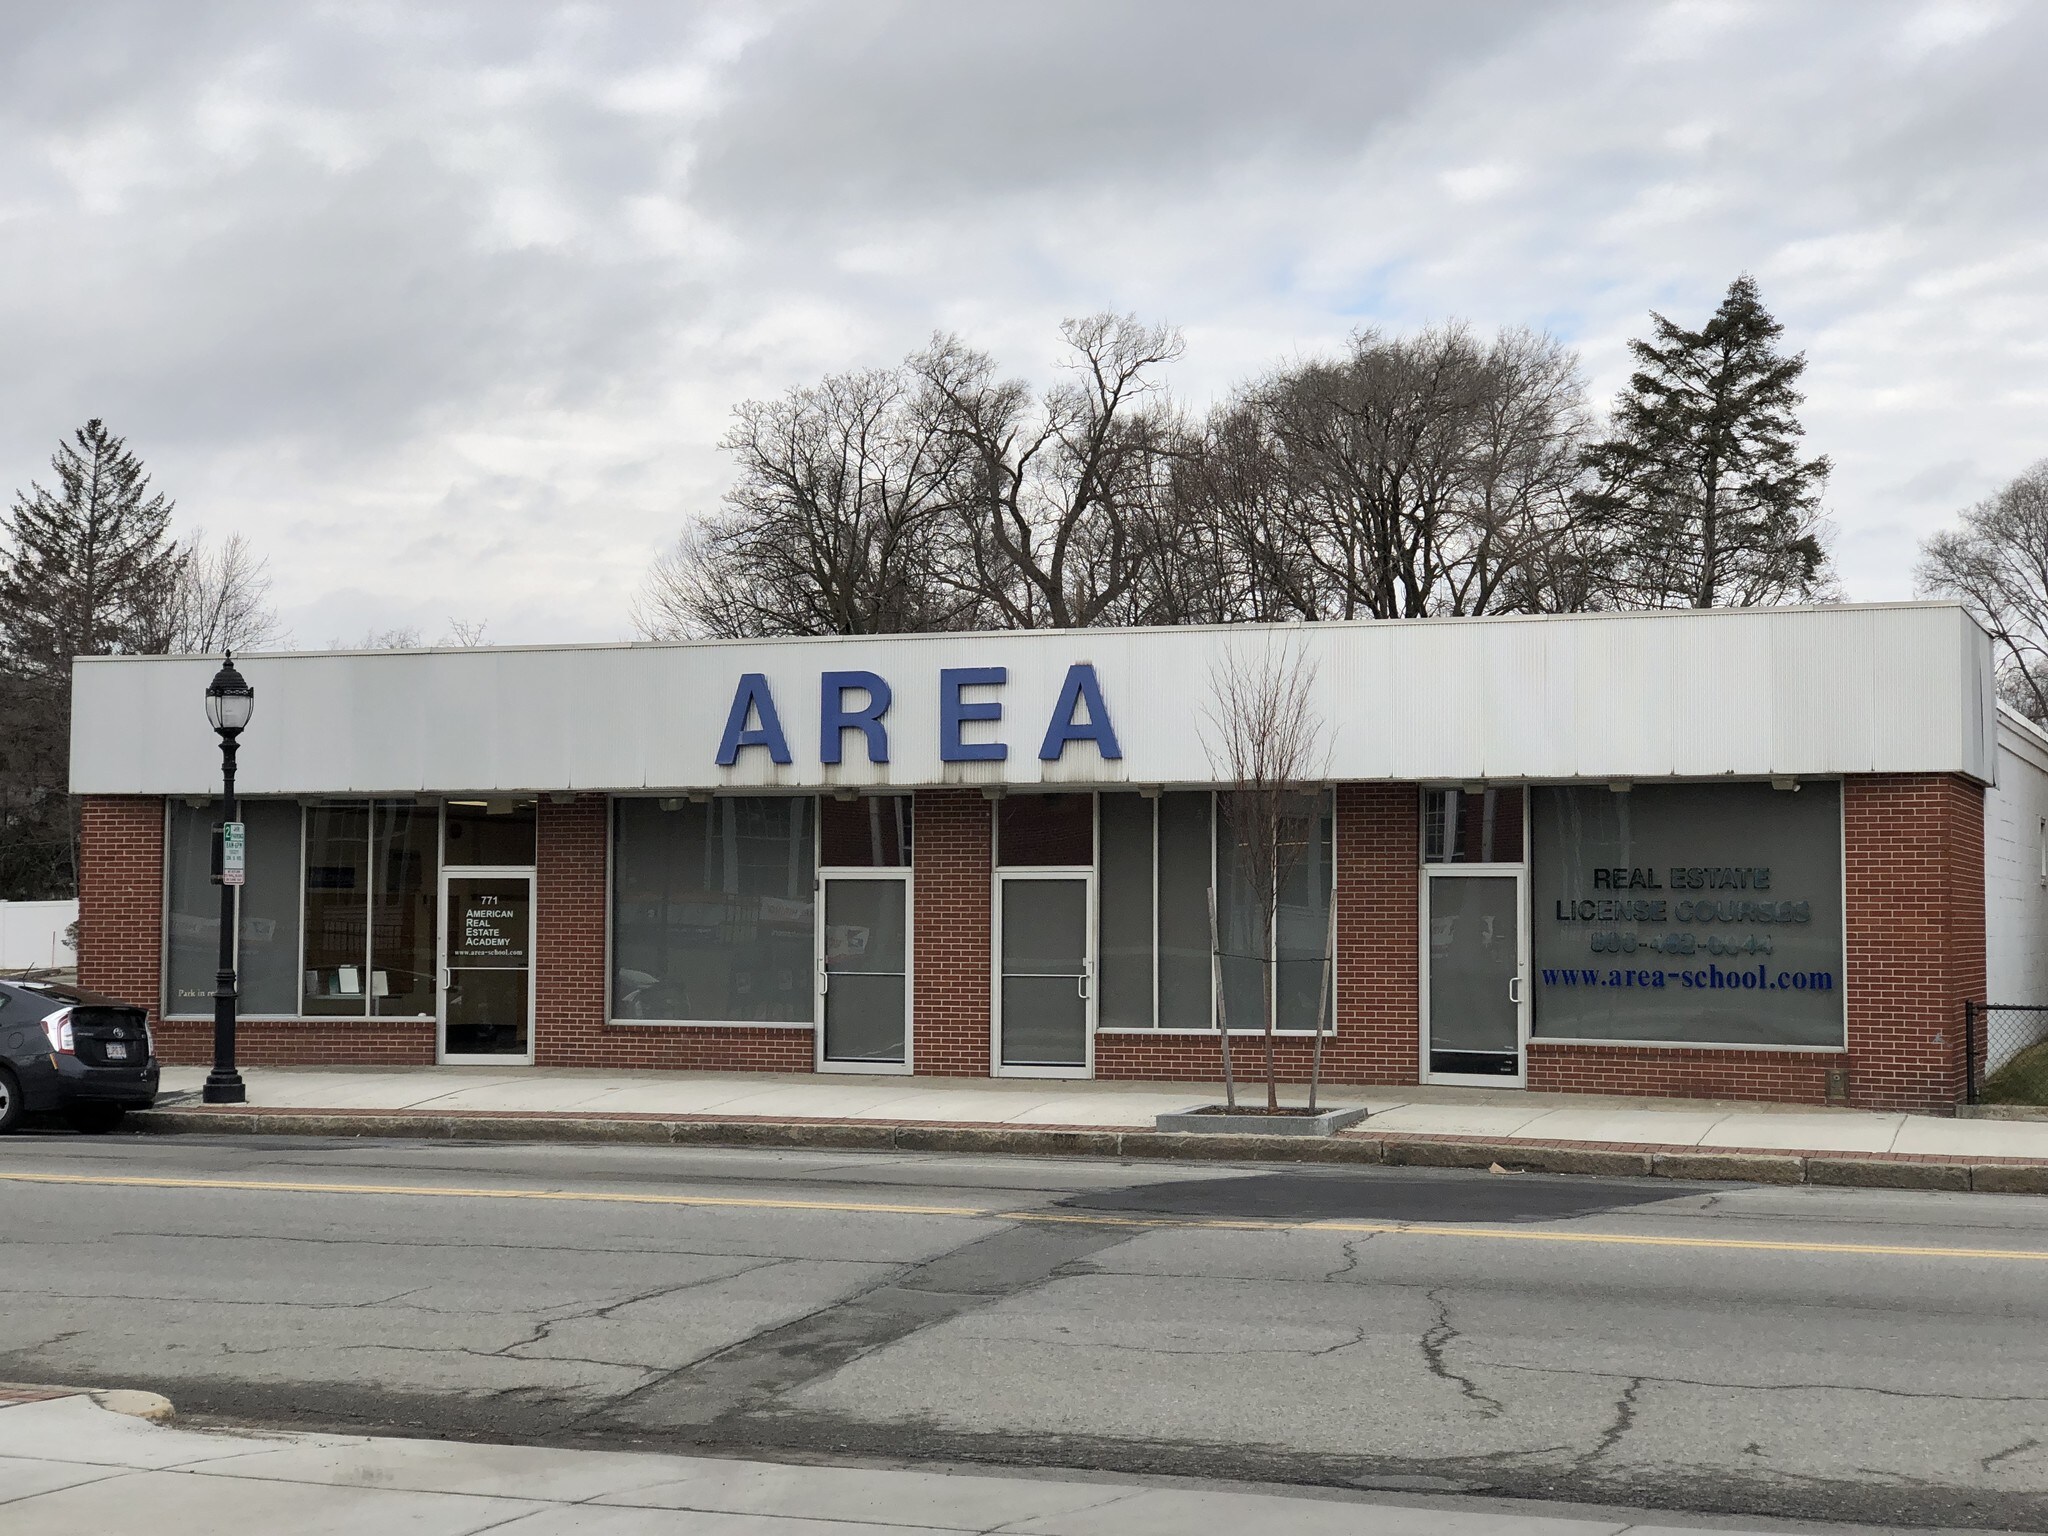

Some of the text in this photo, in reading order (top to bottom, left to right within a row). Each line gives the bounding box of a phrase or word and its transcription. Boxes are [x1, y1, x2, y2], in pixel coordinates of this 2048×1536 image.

[715, 664, 1122, 765] AREA
[225, 826, 231, 838] 2
[1593, 867, 1772, 890] REAL ESTATE
[480, 895, 498, 905] 771
[465, 908, 514, 918] AMERICAN
[1556, 899, 1668, 922] LICENSE
[465, 918, 491, 927] REAL
[465, 927, 500, 937] ESTATE
[465, 937, 511, 946] ACADEMY
[1541, 963, 1834, 991] www.area-school.com
[178, 989, 196, 997] Park
[197, 989, 205, 997] in
